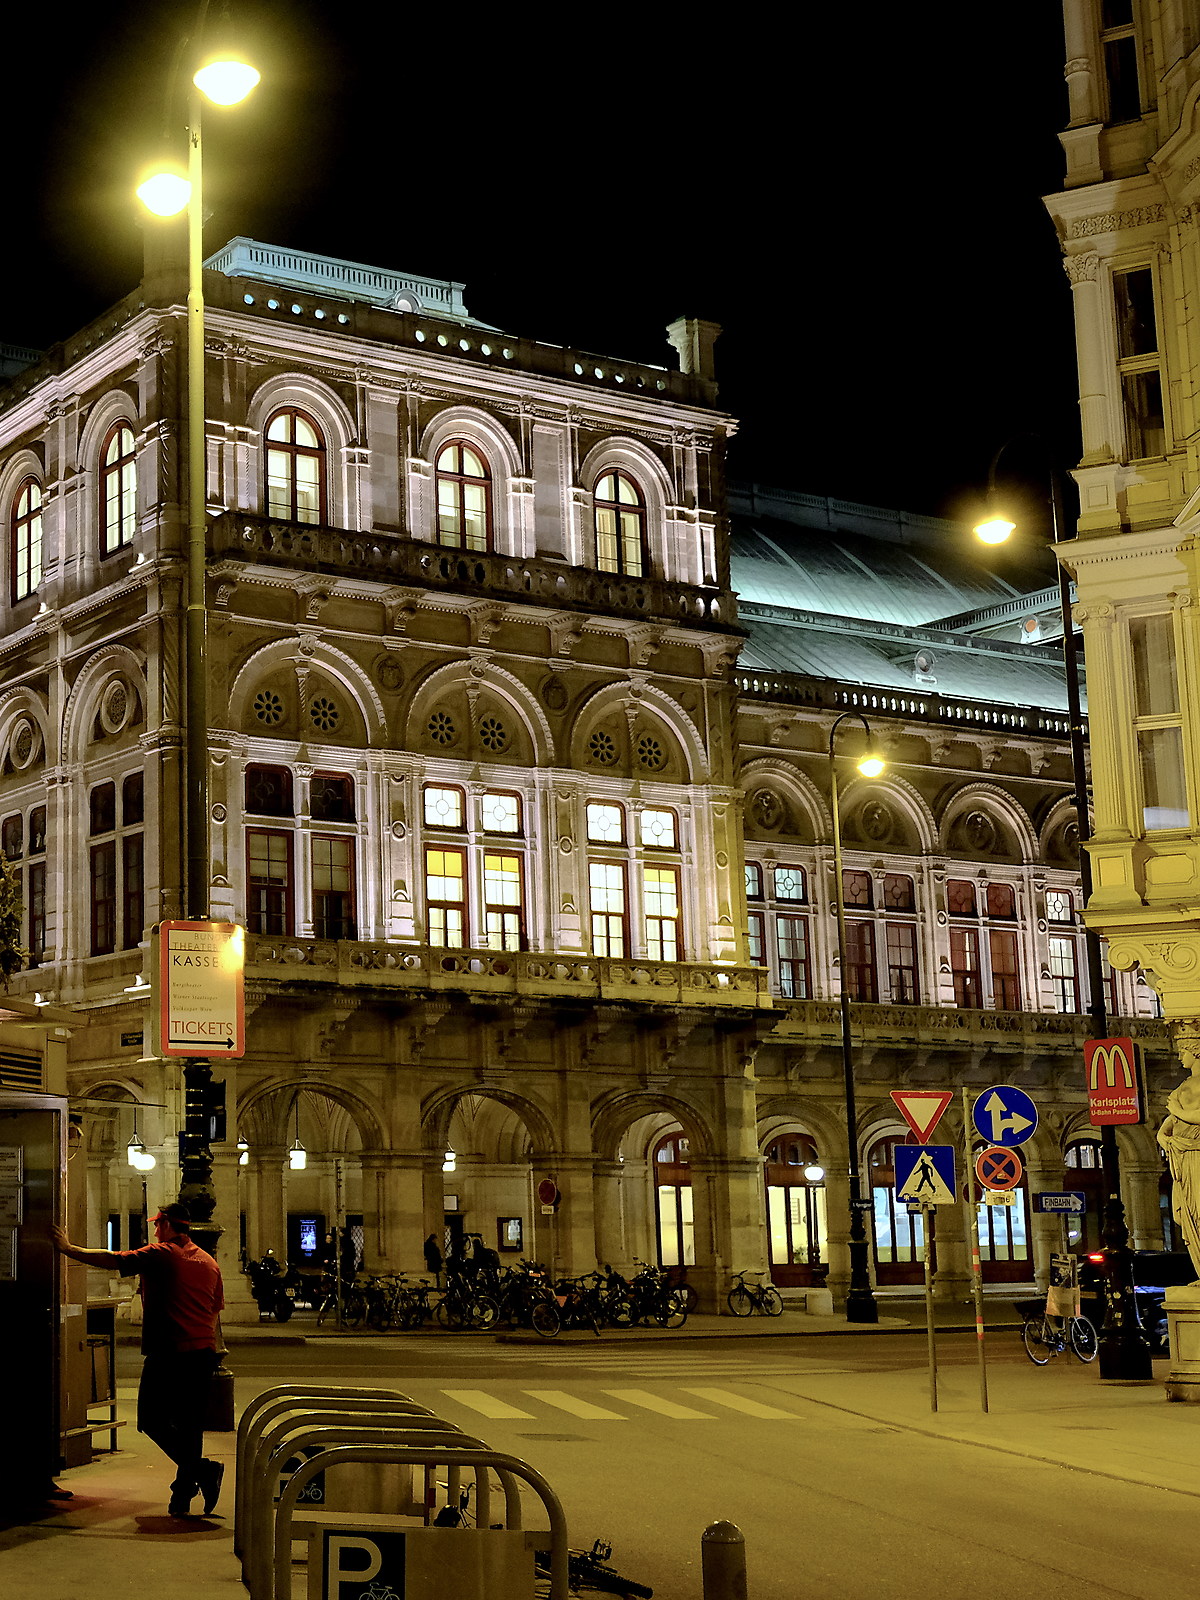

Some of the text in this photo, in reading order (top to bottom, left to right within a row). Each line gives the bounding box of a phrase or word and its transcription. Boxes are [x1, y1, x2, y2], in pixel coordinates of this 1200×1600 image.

[171, 1020, 233, 1036] TICKETS
[1090, 1096, 1136, 1108] Karlsplatz
[1112, 1108, 1137, 1116] Passage
